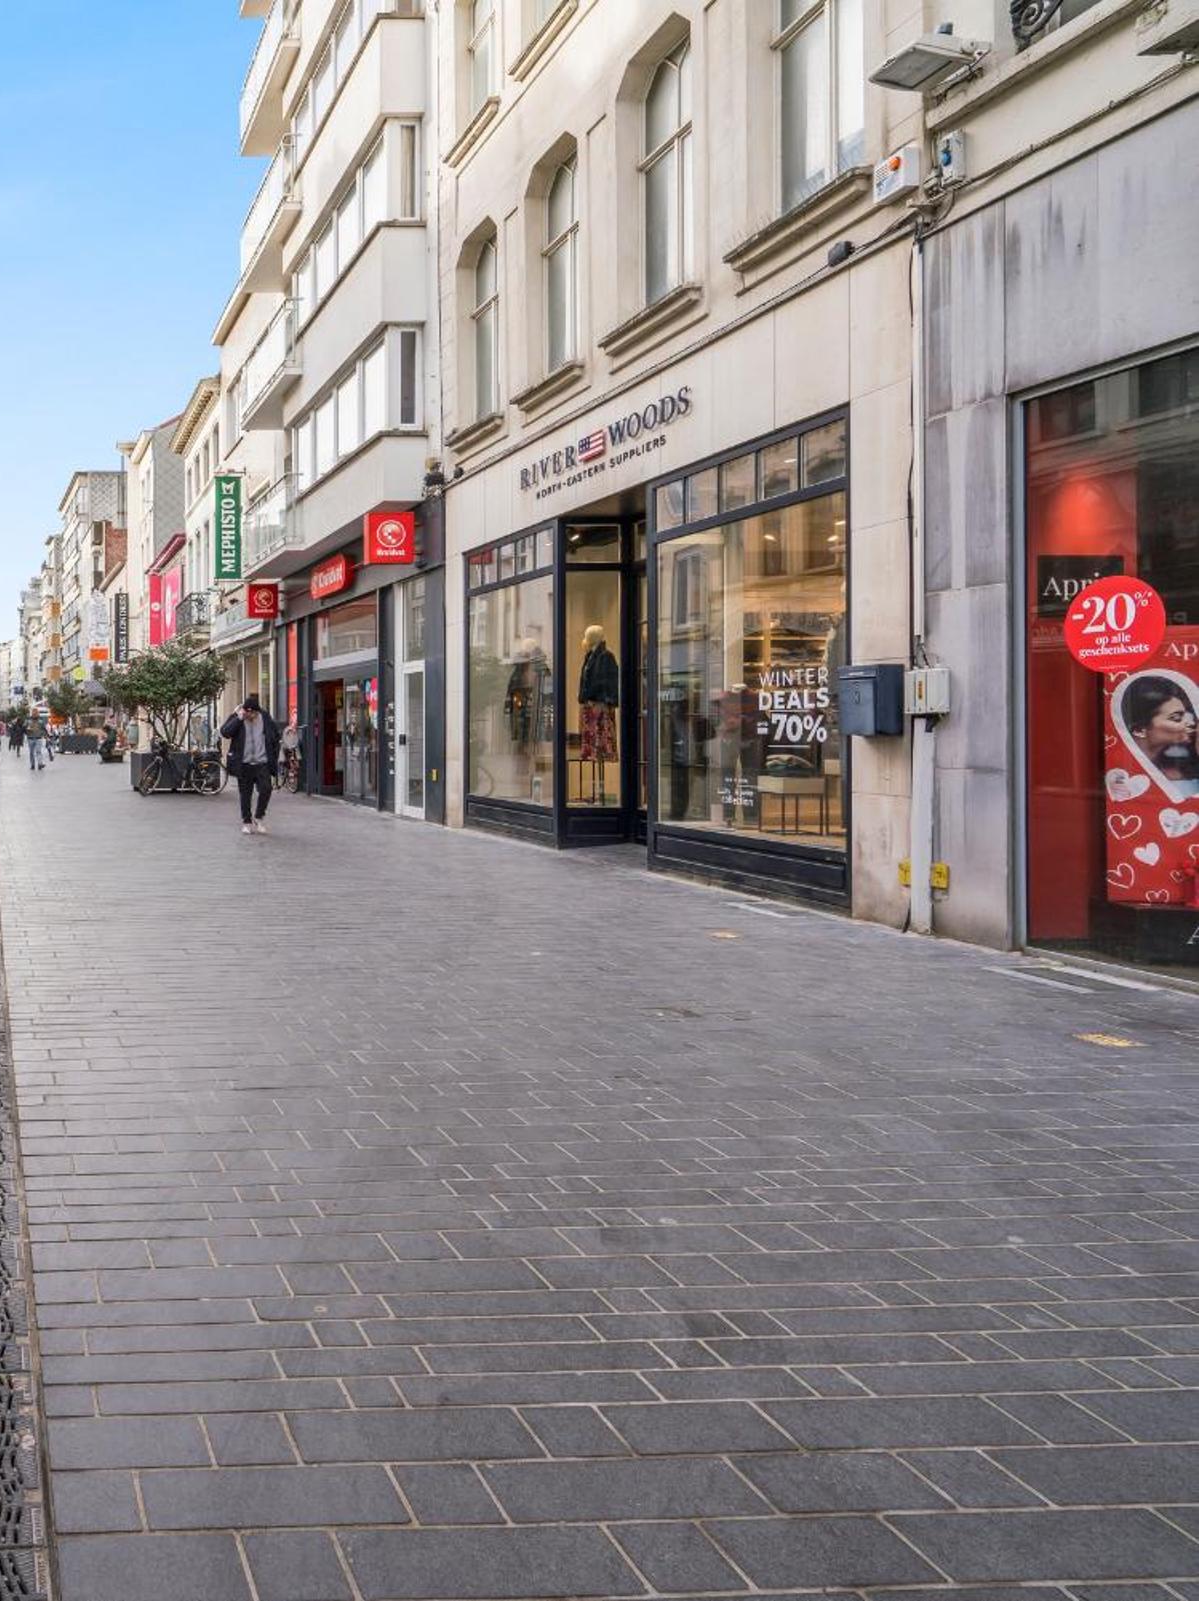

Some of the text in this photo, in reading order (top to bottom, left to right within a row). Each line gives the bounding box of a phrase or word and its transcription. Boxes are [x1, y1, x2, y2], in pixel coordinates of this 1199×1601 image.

[519, 385, 692, 491] RIVER WOODS
[536, 435, 667, 500] NORTH-EASTERN SUPPLIERS
[221, 498, 236, 572] MEPHISTO
[1078, 642, 1150, 660] geschenksets
[1095, 631, 1132, 649] op alle
[758, 666, 829, 687] WINTER
[758, 687, 830, 711] DEALS
